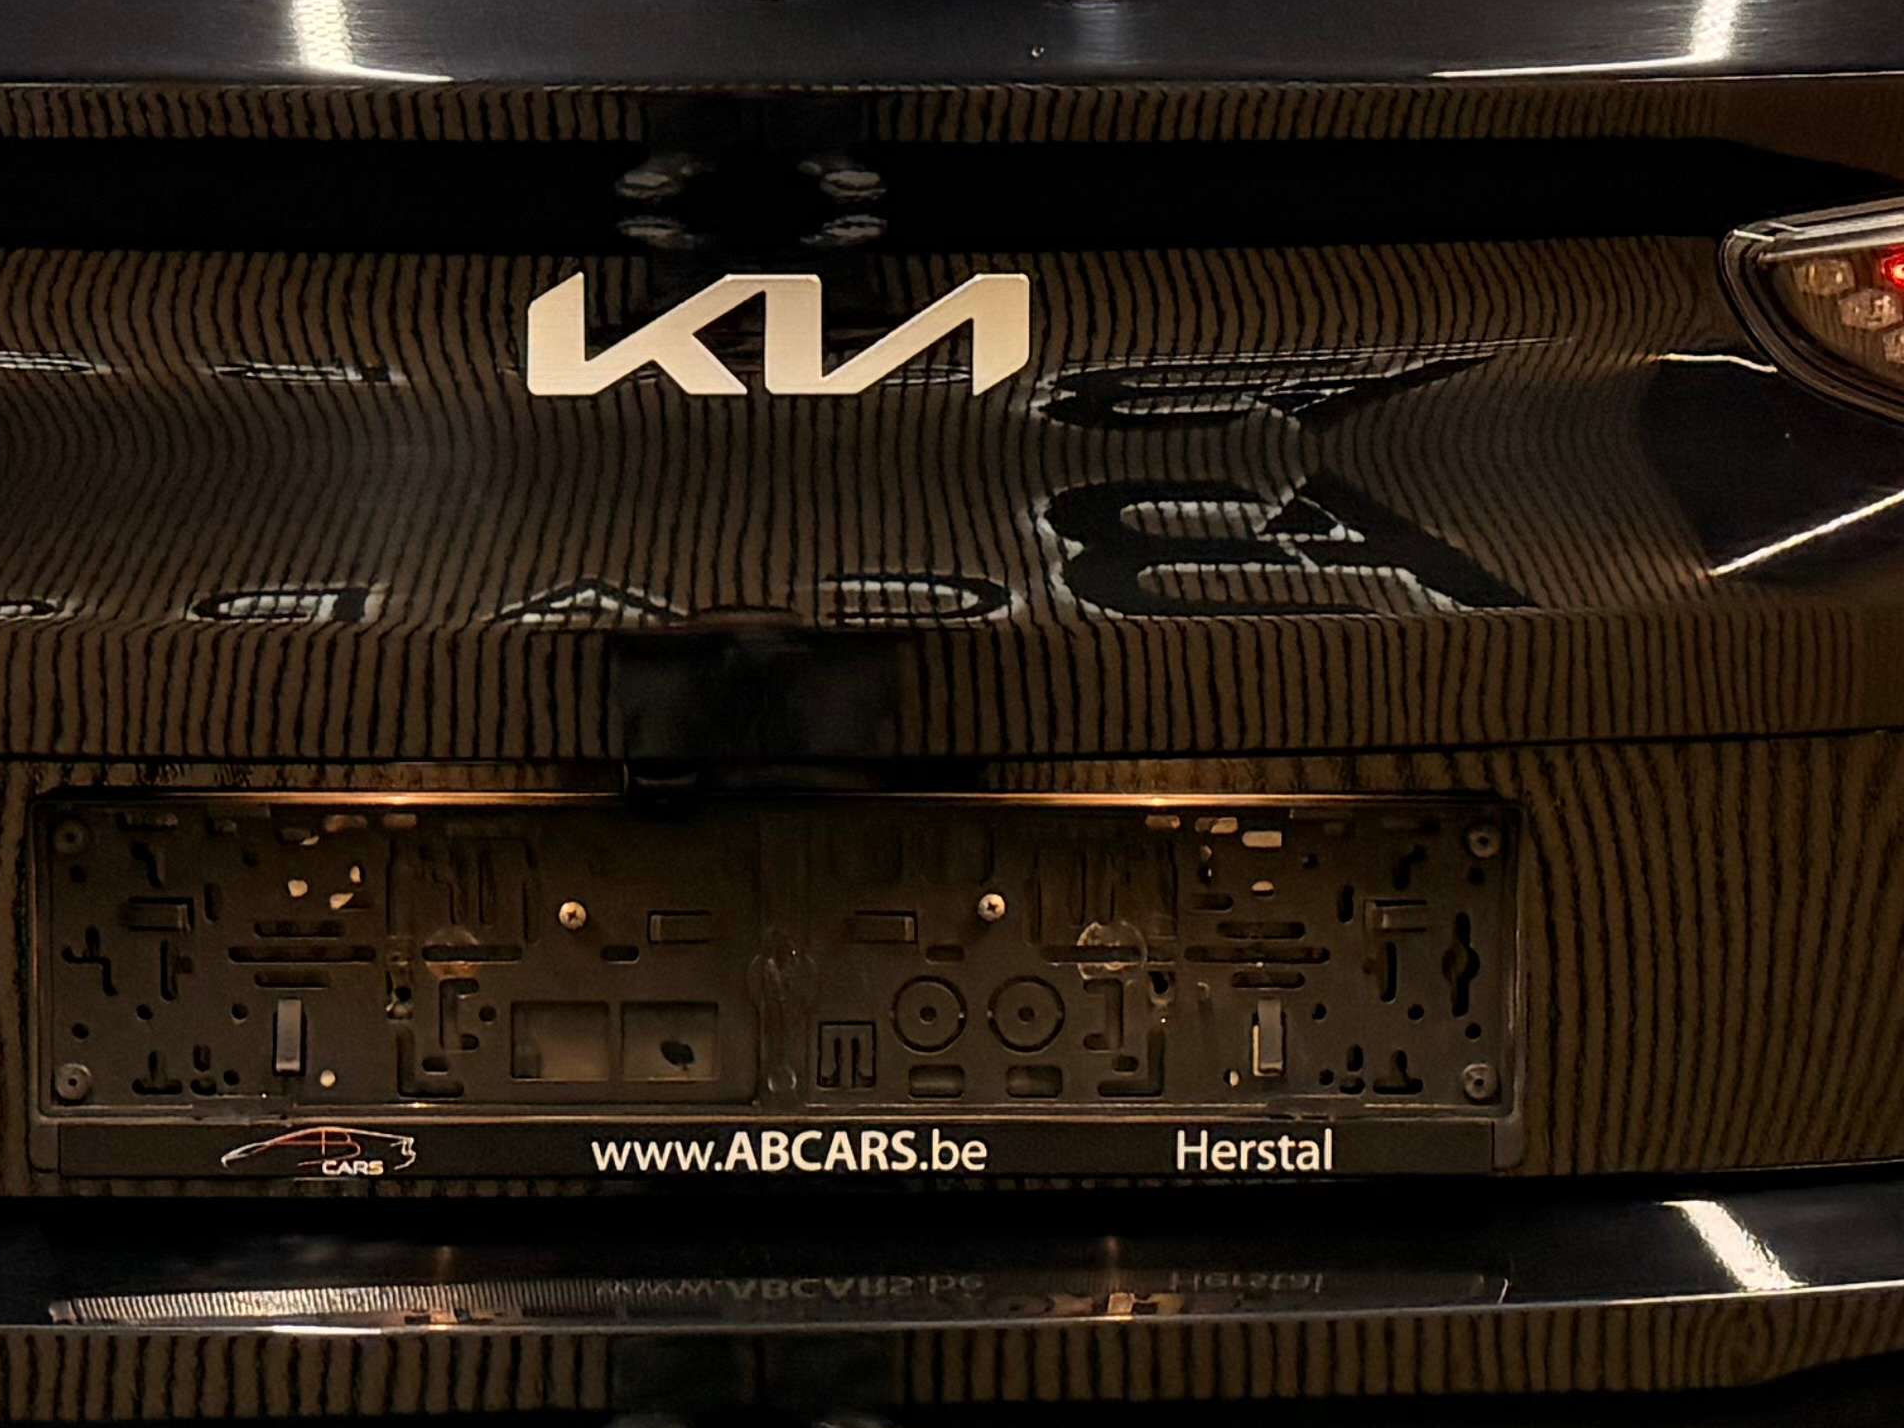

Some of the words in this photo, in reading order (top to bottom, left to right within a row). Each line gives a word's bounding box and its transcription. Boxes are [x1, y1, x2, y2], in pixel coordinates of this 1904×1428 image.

[528, 272, 1030, 396] KIA
[322, 1160, 384, 1176] CARS
[592, 1129, 988, 1172] www.ABCARS.be
[1176, 1128, 1333, 1170] Herstal
